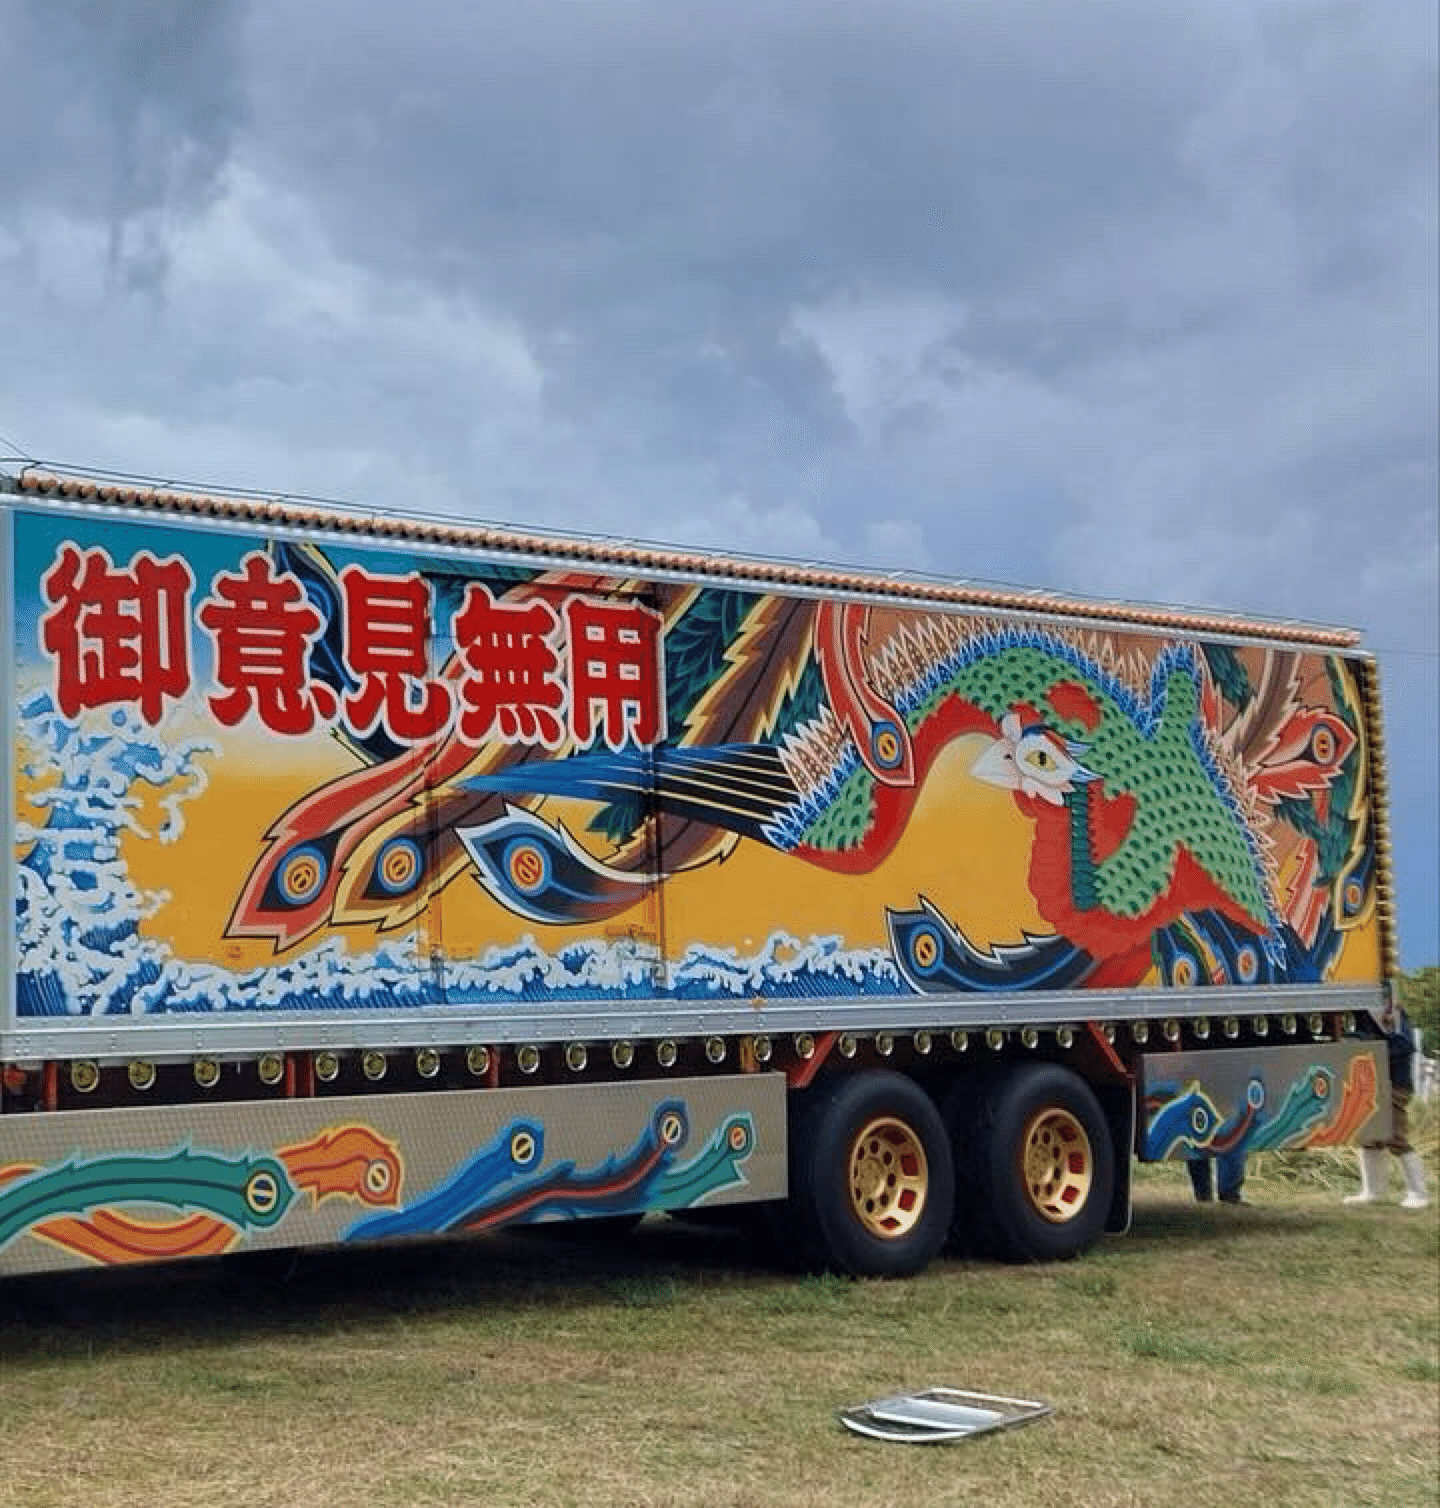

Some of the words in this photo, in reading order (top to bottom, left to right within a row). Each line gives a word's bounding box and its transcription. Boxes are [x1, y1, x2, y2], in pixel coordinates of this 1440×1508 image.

[40, 541, 666, 748] 御意見無用
